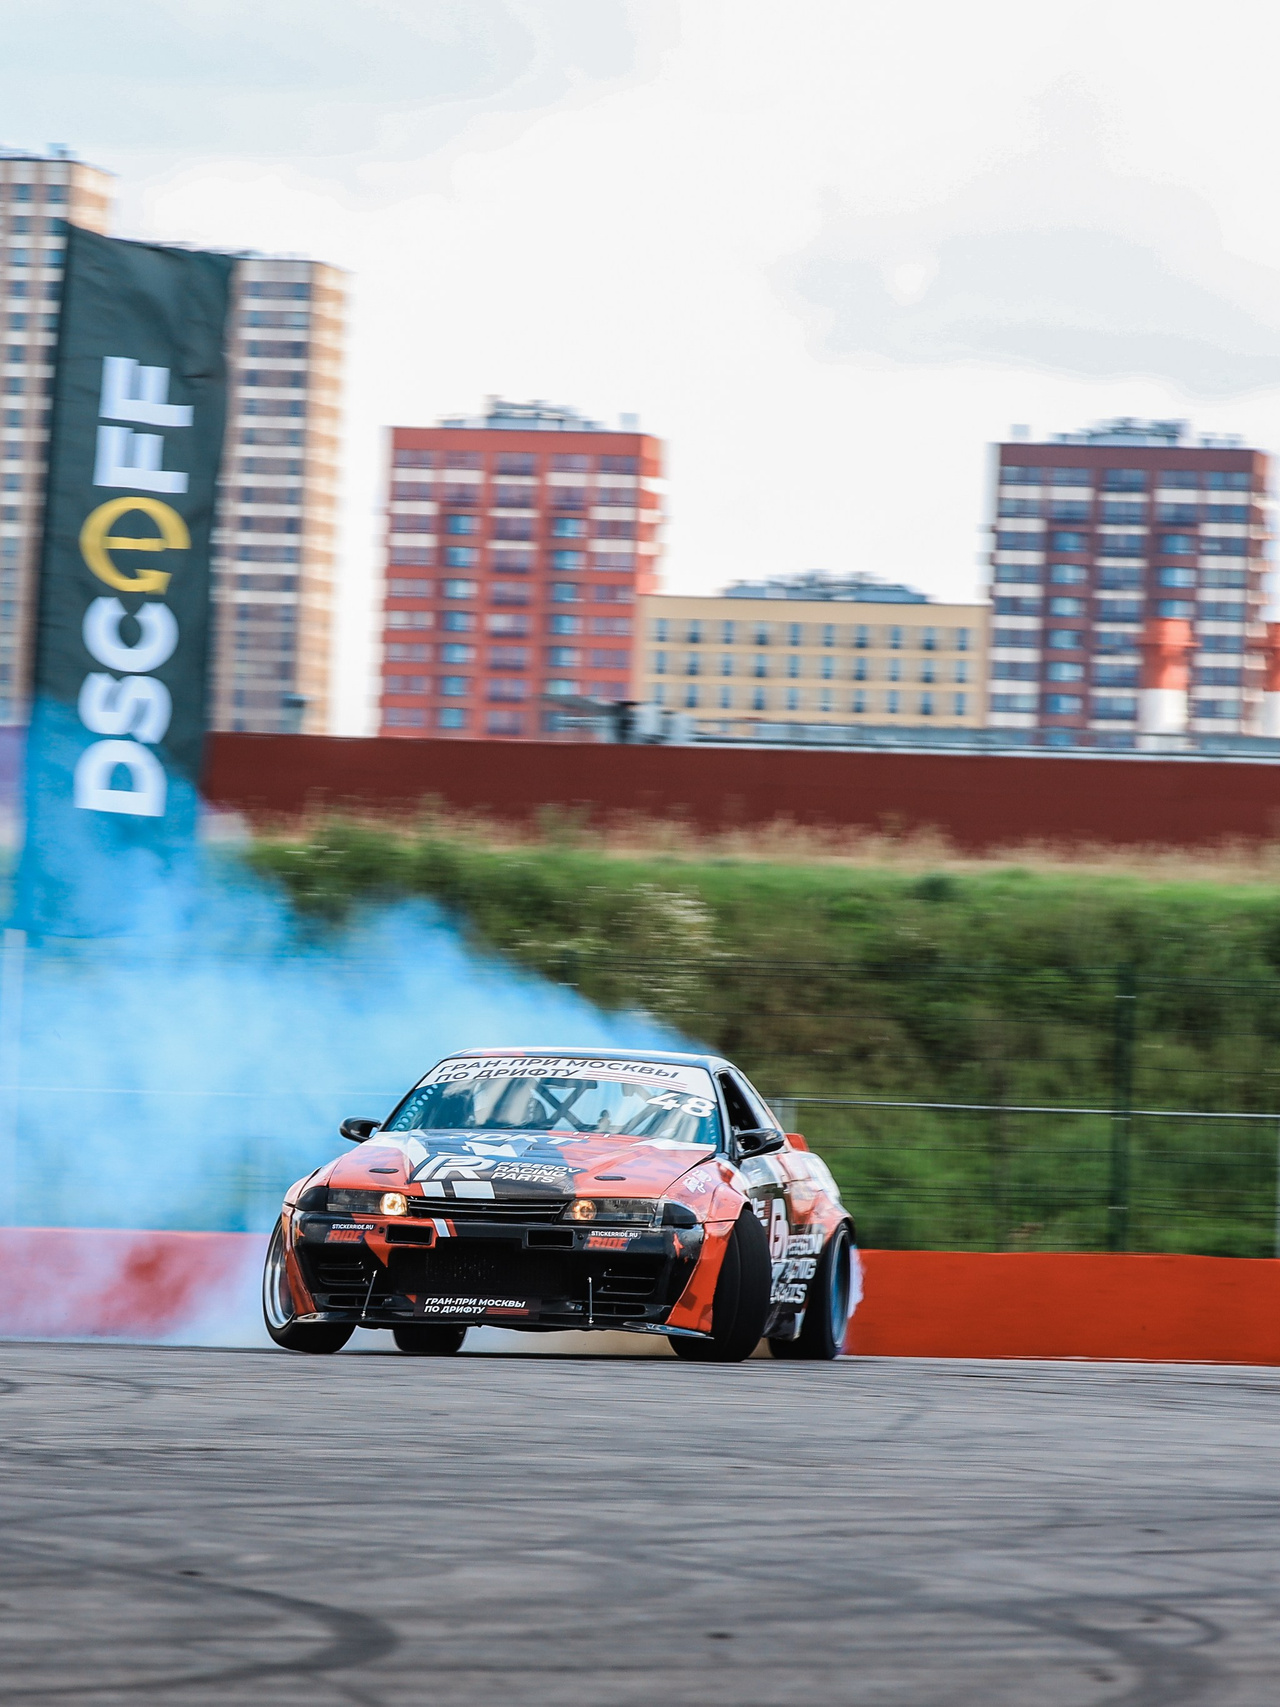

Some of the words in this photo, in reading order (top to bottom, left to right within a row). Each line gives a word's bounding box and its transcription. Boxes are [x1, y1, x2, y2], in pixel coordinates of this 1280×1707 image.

[437, 1058, 561, 1074] ГРАН-ПРИ
[566, 1058, 680, 1079] МОСКВЫ
[434, 1070, 470, 1082] ПО
[473, 1068, 582, 1080] ДРИФТУ
[646, 1091, 718, 1118] 48
[490, 1172, 556, 1184] PARTS
[493, 1166, 567, 1178] RACING
[328, 1230, 364, 1242] RIDE
[587, 1236, 629, 1248] RIDE
[425, 1297, 477, 1306] ГРАН-ПРИ
[478, 1298, 527, 1308] МОСКВЫ
[424, 1305, 440, 1313] ПО
[440, 1305, 486, 1314] ДРИФТУ
